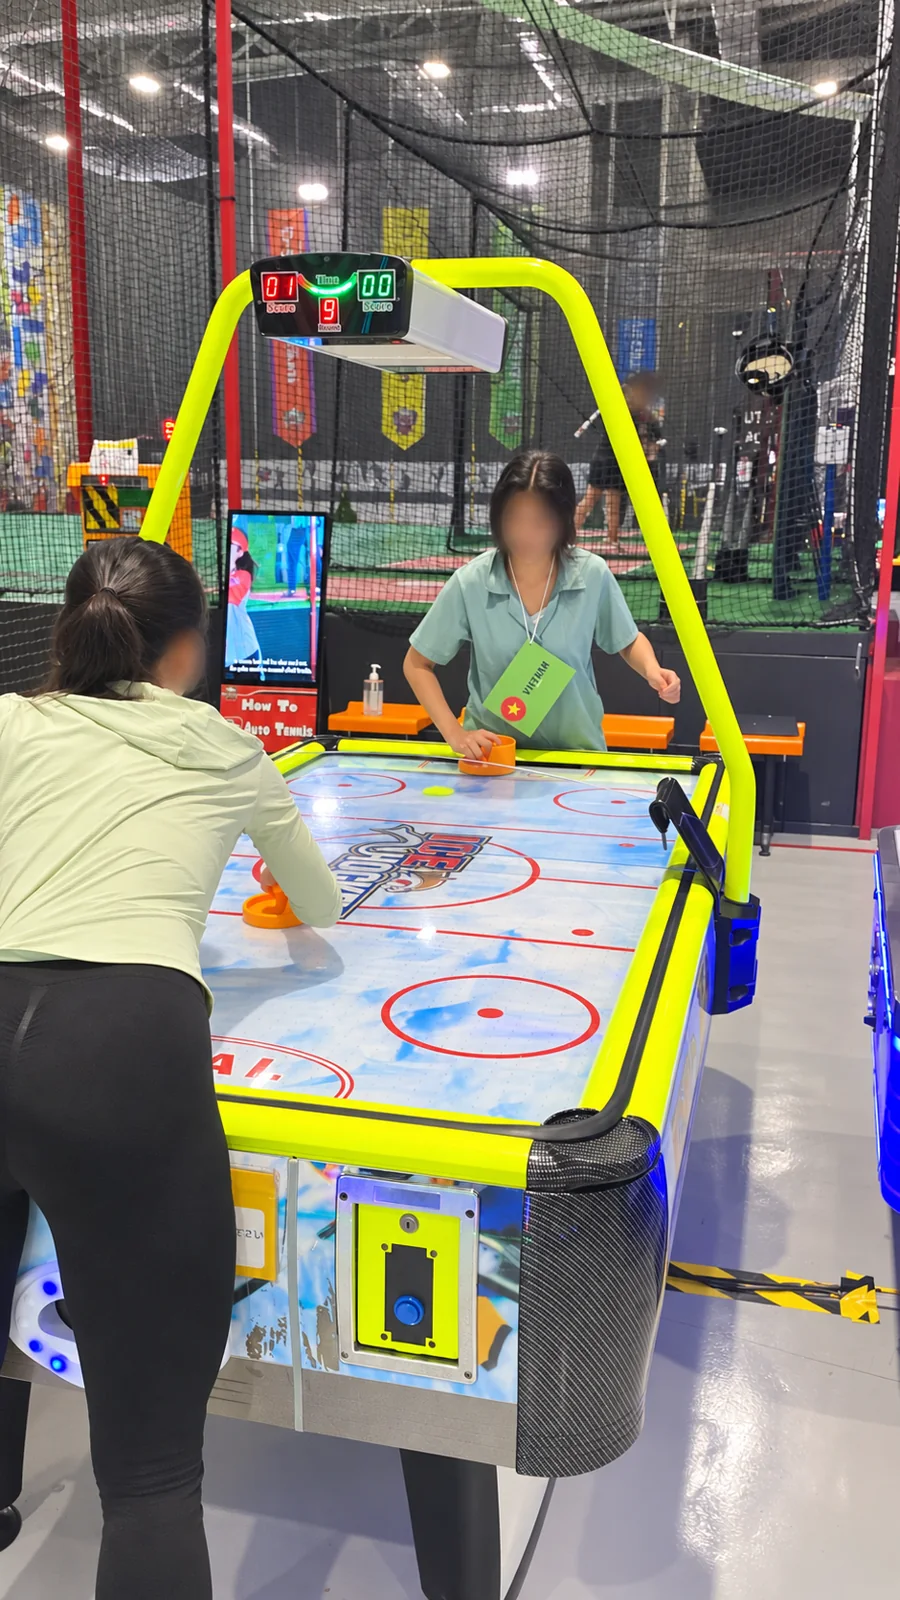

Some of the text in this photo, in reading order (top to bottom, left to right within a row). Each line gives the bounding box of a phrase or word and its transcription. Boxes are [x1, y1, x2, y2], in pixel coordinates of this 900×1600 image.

[265, 276, 294, 297] 01
[362, 274, 392, 297] 00
[267, 302, 296, 313] Score
[323, 299, 336, 321] 9
[363, 302, 393, 312] Score
[241, 698, 298, 712] How To
[244, 721, 314, 737] Auto Tennis
[400, 833, 484, 871] ICE
